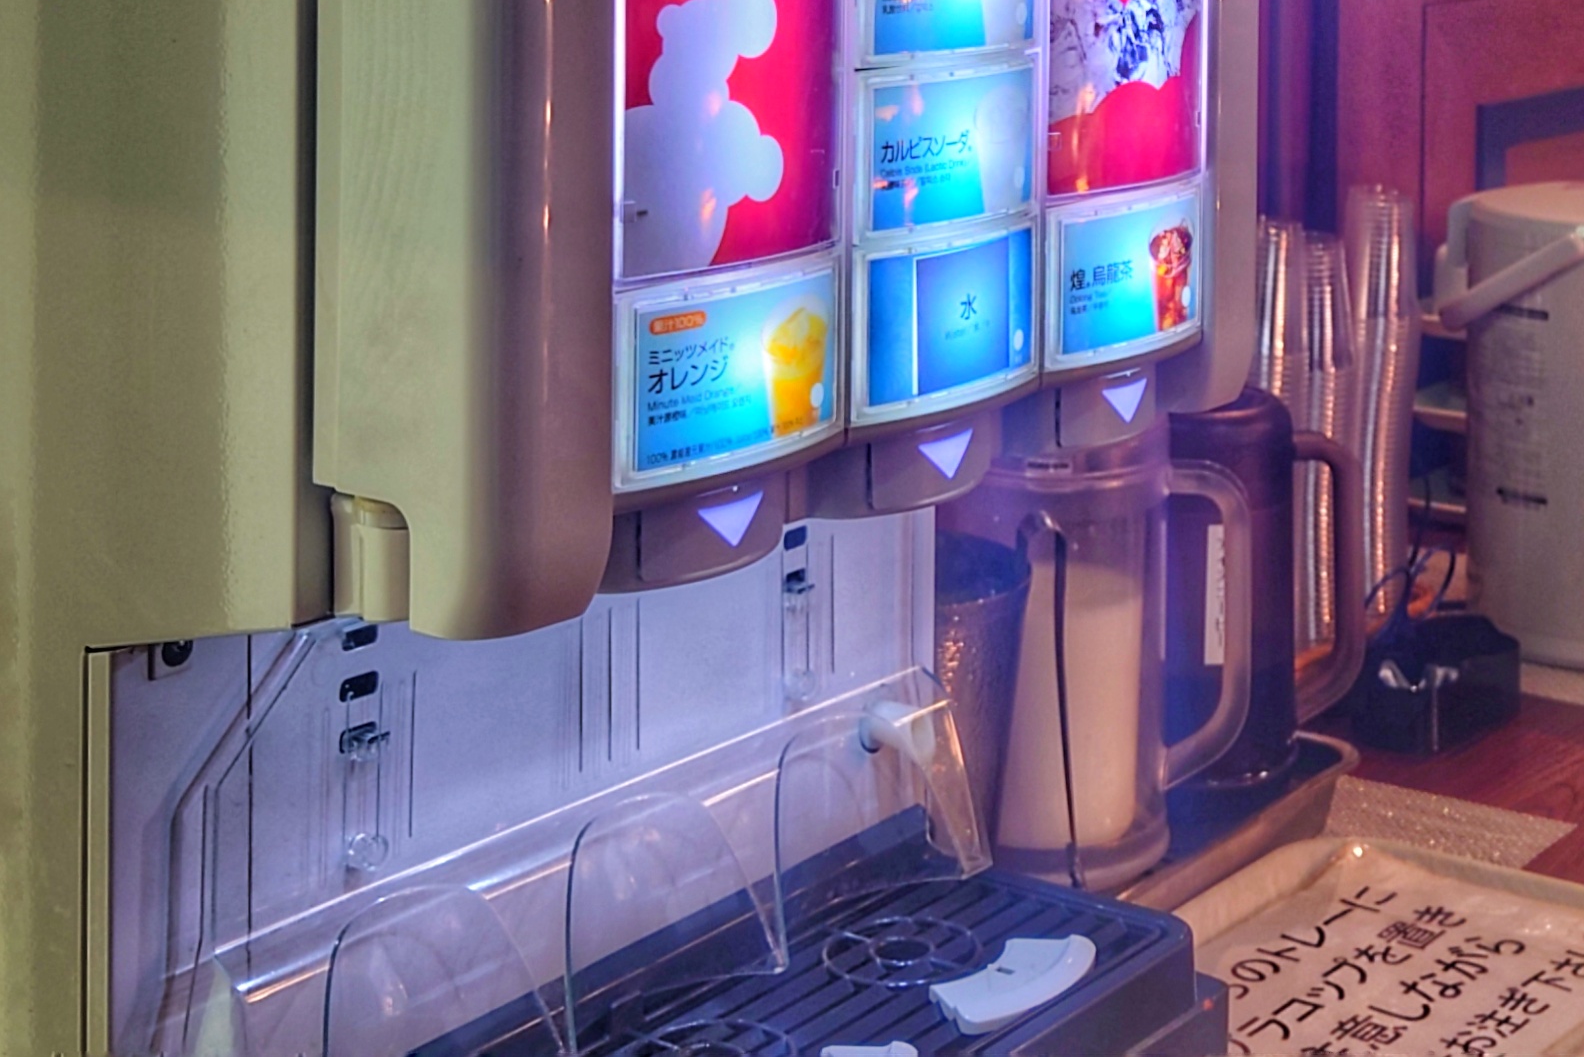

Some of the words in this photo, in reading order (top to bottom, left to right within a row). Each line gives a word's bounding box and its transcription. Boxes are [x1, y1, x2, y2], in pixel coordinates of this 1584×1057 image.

[880, 129, 970, 164] カルピスソーダ
[960, 293, 977, 320] 水
[648, 336, 729, 365] ミニッツメイド
[647, 355, 728, 394] オレンジ
[647, 396, 679, 412] Minute
